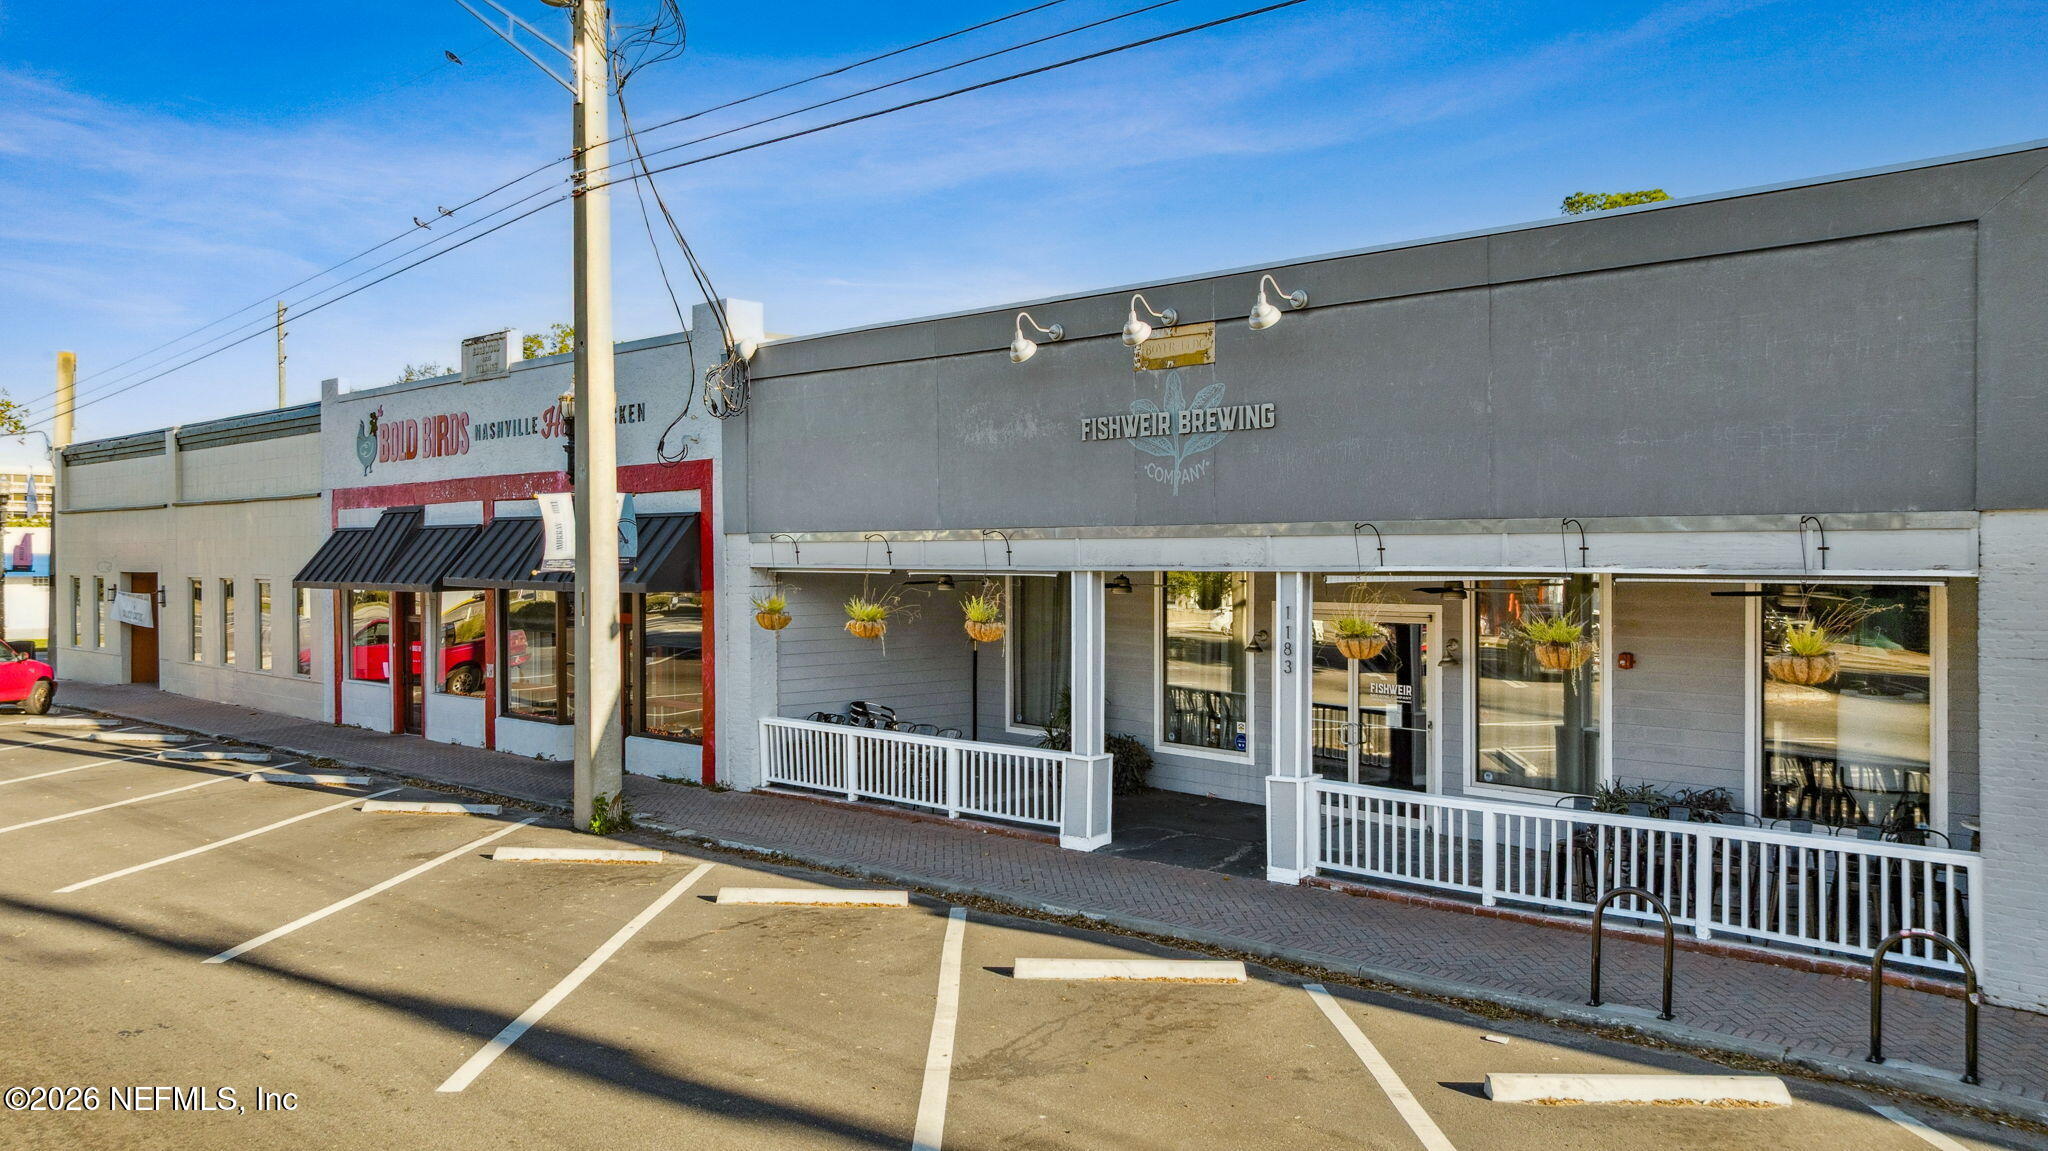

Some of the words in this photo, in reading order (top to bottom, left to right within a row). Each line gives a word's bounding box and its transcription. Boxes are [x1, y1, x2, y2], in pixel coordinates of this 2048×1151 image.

[379, 419, 418, 463] BOLD
[422, 412, 470, 458] BIRDS
[474, 416, 539, 442] NASHVILLE
[1081, 412, 1171, 441] FISHWEIR
[1178, 402, 1276, 434] BREWING
[1283, 605, 1292, 674] 1183
[1370, 682, 1412, 696] FISHWEIR
